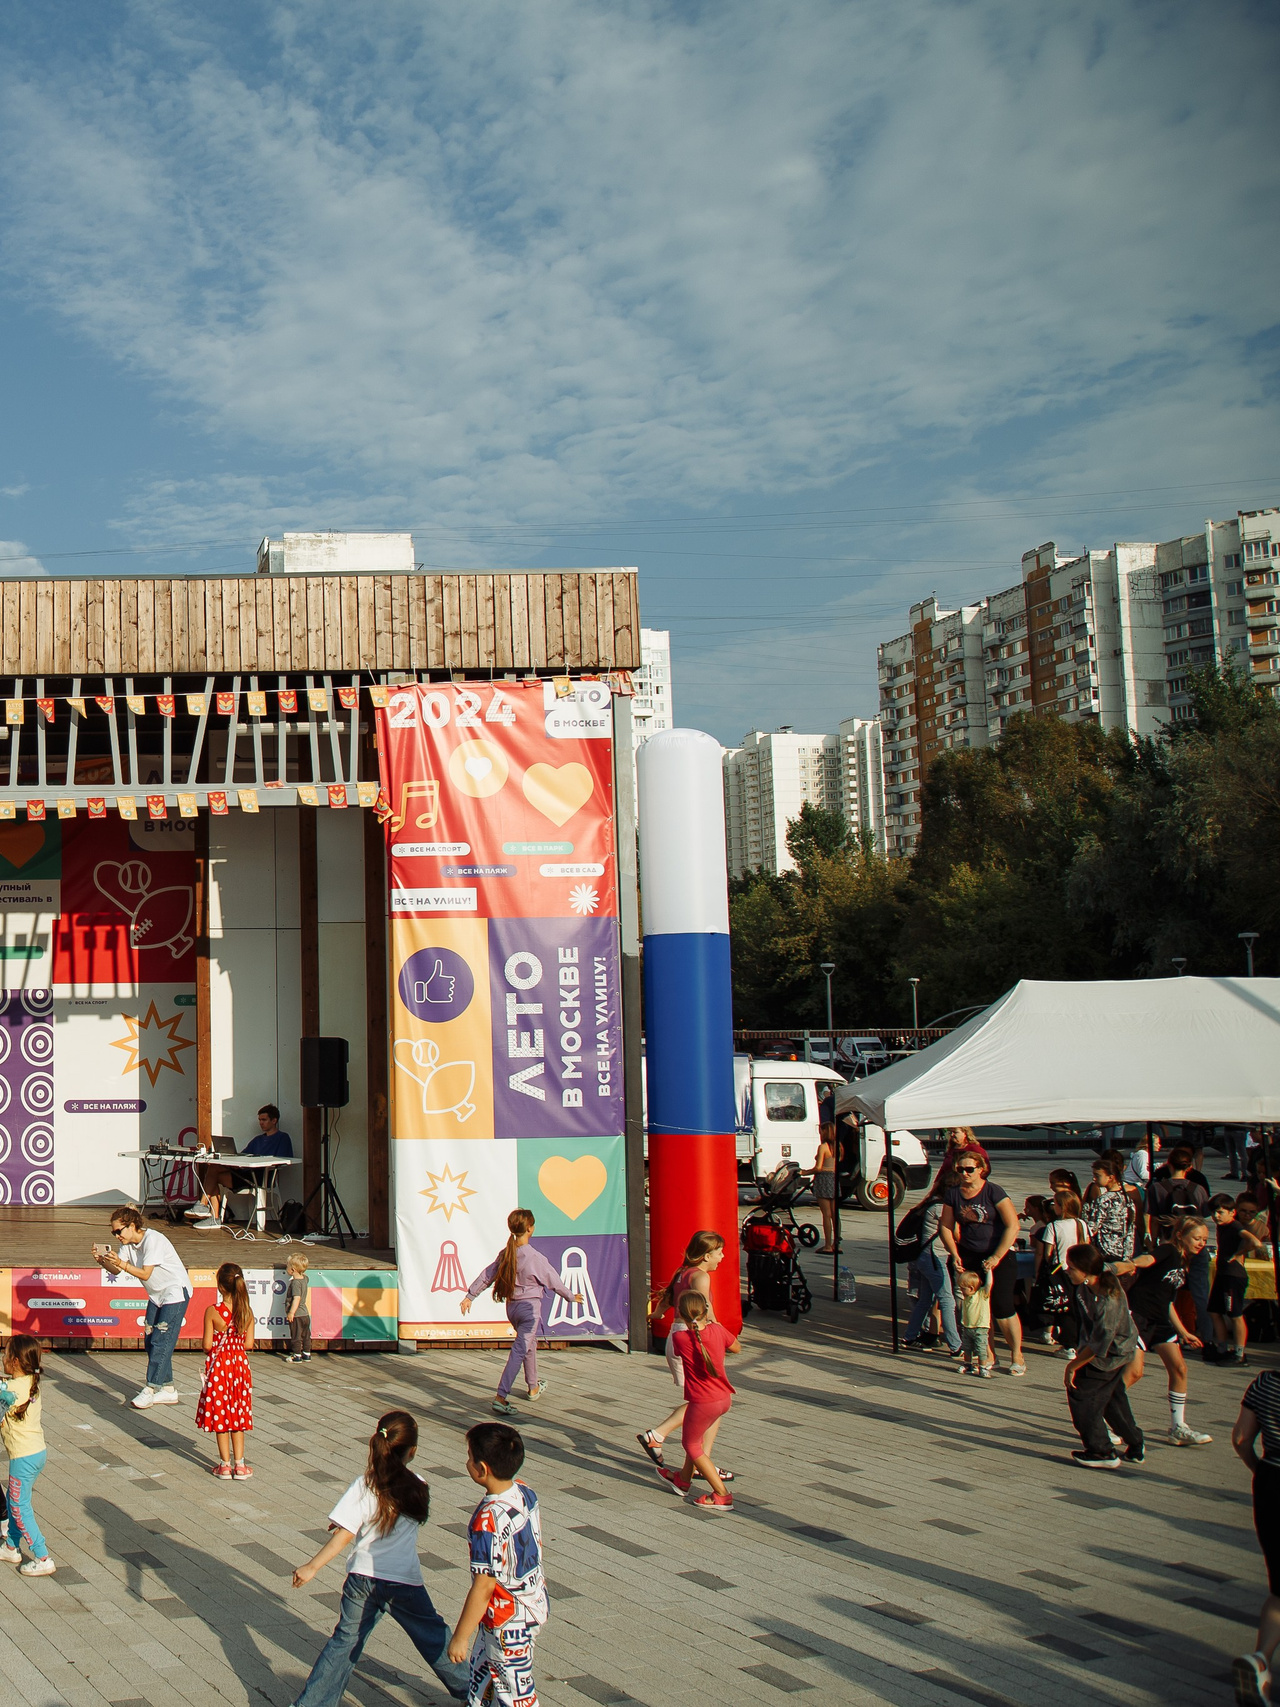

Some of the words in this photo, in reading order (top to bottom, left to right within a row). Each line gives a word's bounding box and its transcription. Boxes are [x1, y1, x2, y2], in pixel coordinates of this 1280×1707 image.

[554, 690, 601, 702] ЕТО
[388, 692, 516, 728] 2024
[75, 766, 111, 782] 202
[144, 820, 155, 832] В
[160, 820, 195, 832] МОС
[394, 898, 414, 906] ВСЕ
[594, 956, 608, 1026] УЛИЦУ!
[558, 946, 583, 1079] МОСКВЕ
[504, 951, 546, 1101] ЛЕТО
[596, 1029, 610, 1056] НА
[598, 1061, 610, 1096] ВСЕ
[562, 1088, 583, 1108] В
[246, 1280, 286, 1295] ЕТО
[254, 1317, 290, 1326] ОСКВЕ
